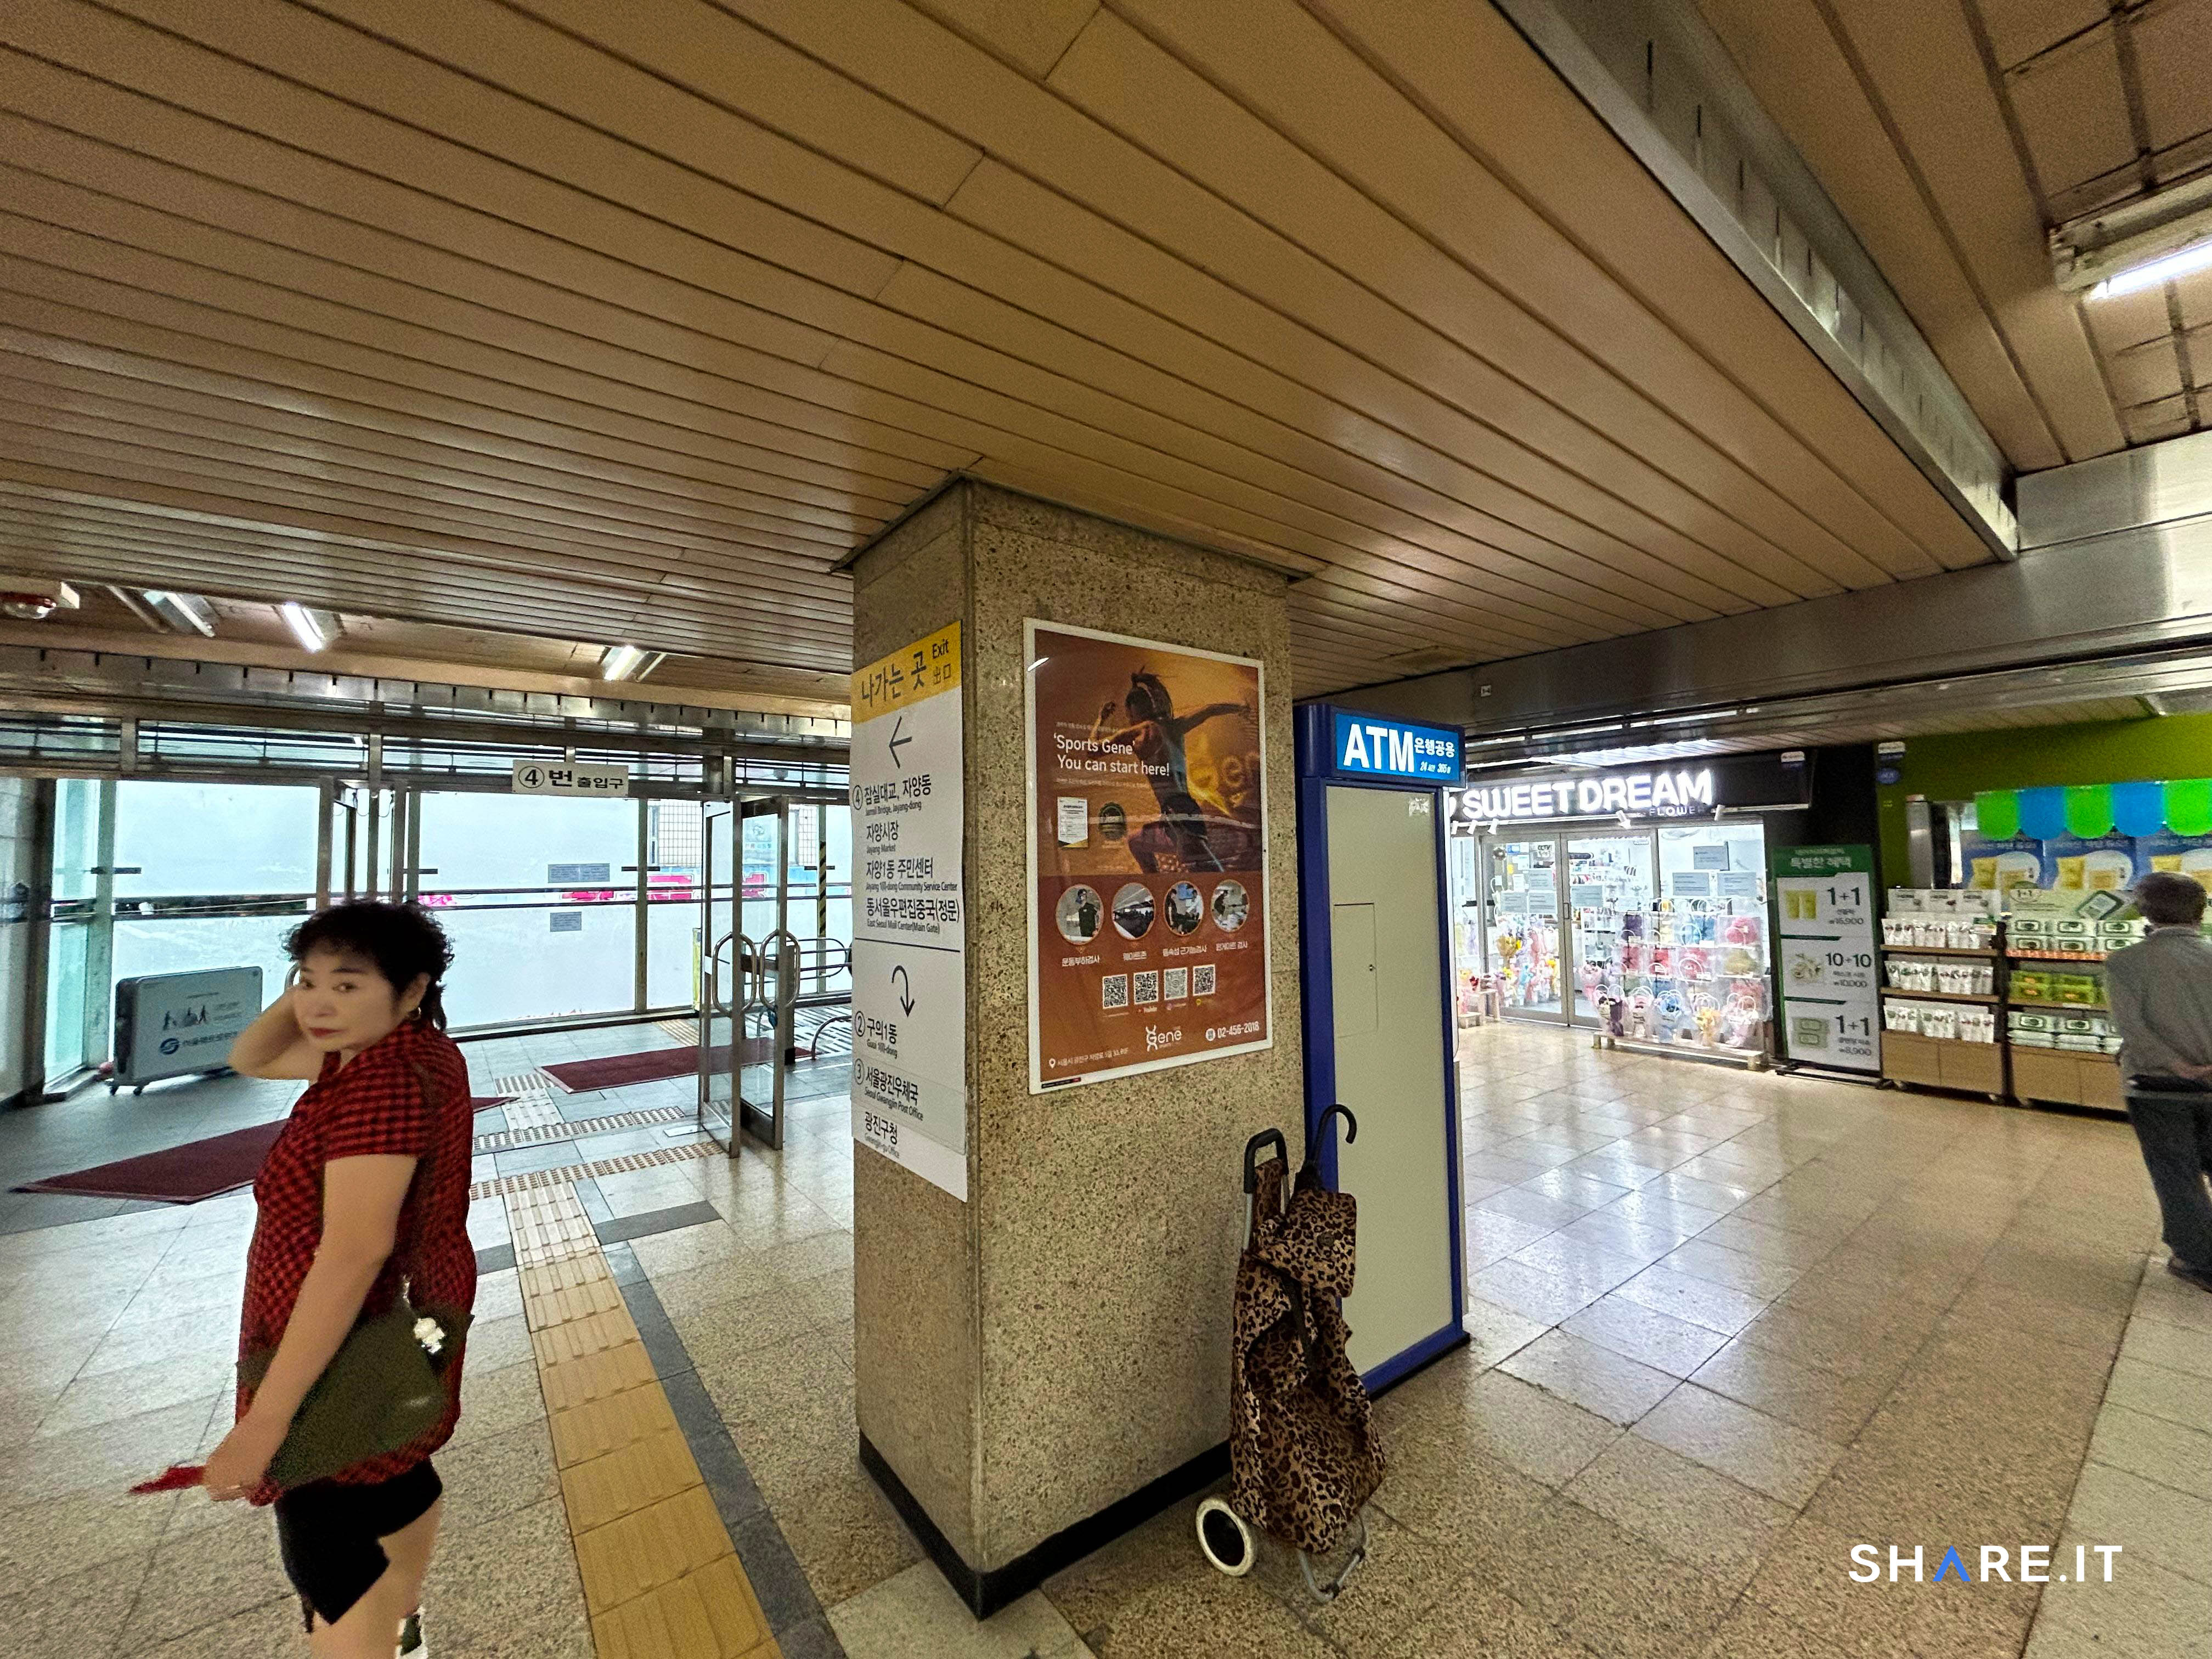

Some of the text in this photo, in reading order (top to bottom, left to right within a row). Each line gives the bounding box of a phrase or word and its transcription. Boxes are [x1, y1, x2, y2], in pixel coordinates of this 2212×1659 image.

[933, 639, 949, 659] Exit
[862, 651, 927, 707] 나가는 곳
[933, 663, 951, 685] 出口
[1344, 723, 1414, 773] ATM
[1414, 737, 1455, 758] 은행공용
[1057, 754, 1170, 776] You can start here!
[578, 777, 624, 789] 출입구
[864, 774, 932, 805] 잠실대교, 자양동
[1463, 769, 1713, 819] SWEET DREAM
[1649, 806, 1705, 816] FLOWE
[866, 820, 899, 843] 자양시장
[866, 857, 933, 879] 자양1동 주민센터
[924, 882, 940, 891] Service
[941, 882, 958, 891] Center
[866, 898, 960, 923] 동서울우편집중국(정문)
[867, 1018, 897, 1045] 구의1동
[866, 1066, 918, 1106] 서울광진우체국
[865, 1111, 898, 1145] 광진구청
